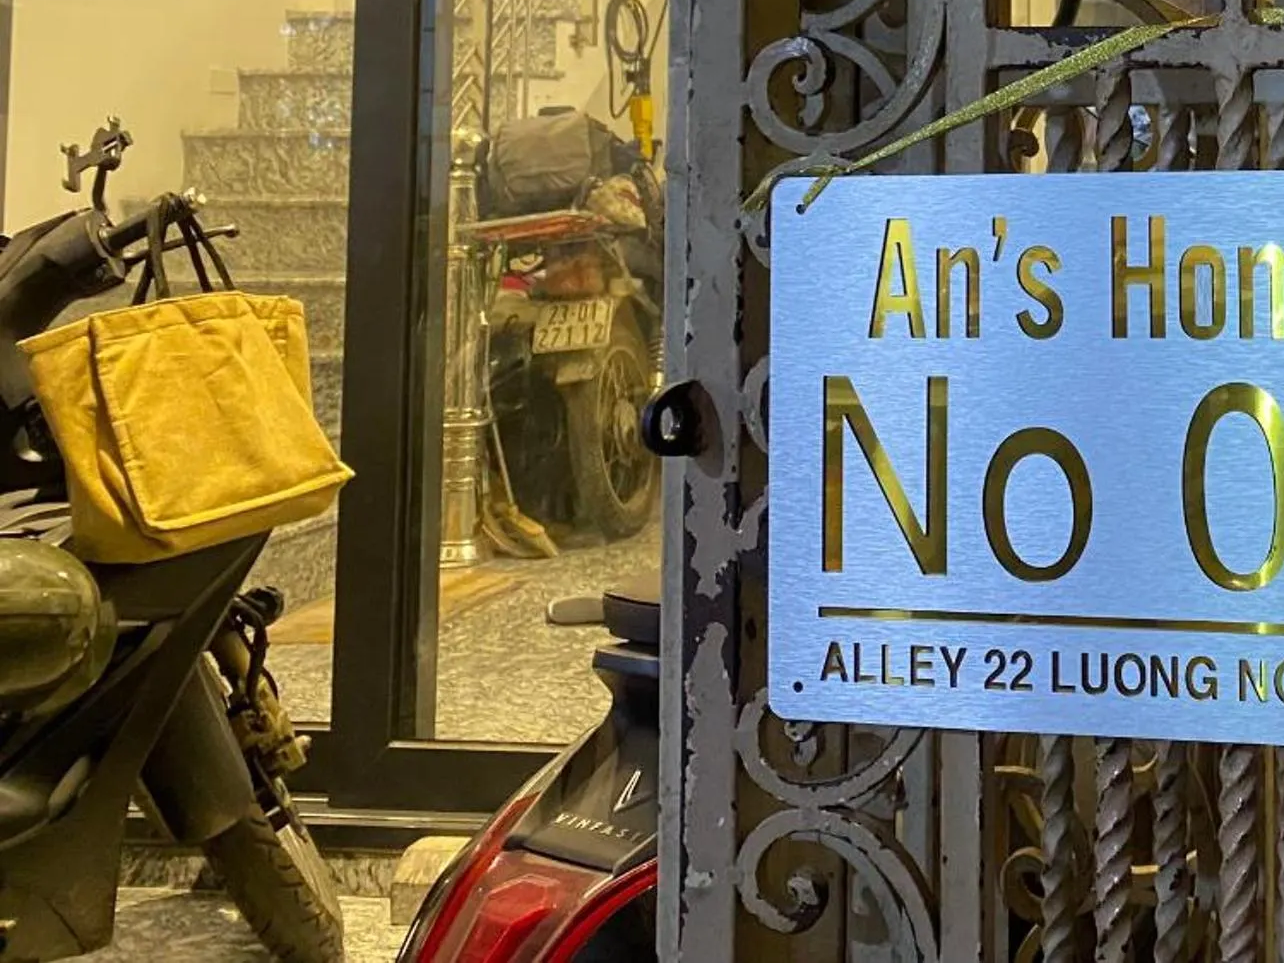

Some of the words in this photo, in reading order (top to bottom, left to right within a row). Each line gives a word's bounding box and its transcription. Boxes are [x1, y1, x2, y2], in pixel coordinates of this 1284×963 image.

[869, 217, 1065, 340] An's
[821, 375, 1094, 582] No
[820, 641, 969, 689] ALLEY
[983, 648, 1035, 693] 22
[1051, 651, 1220, 702] LUONG
